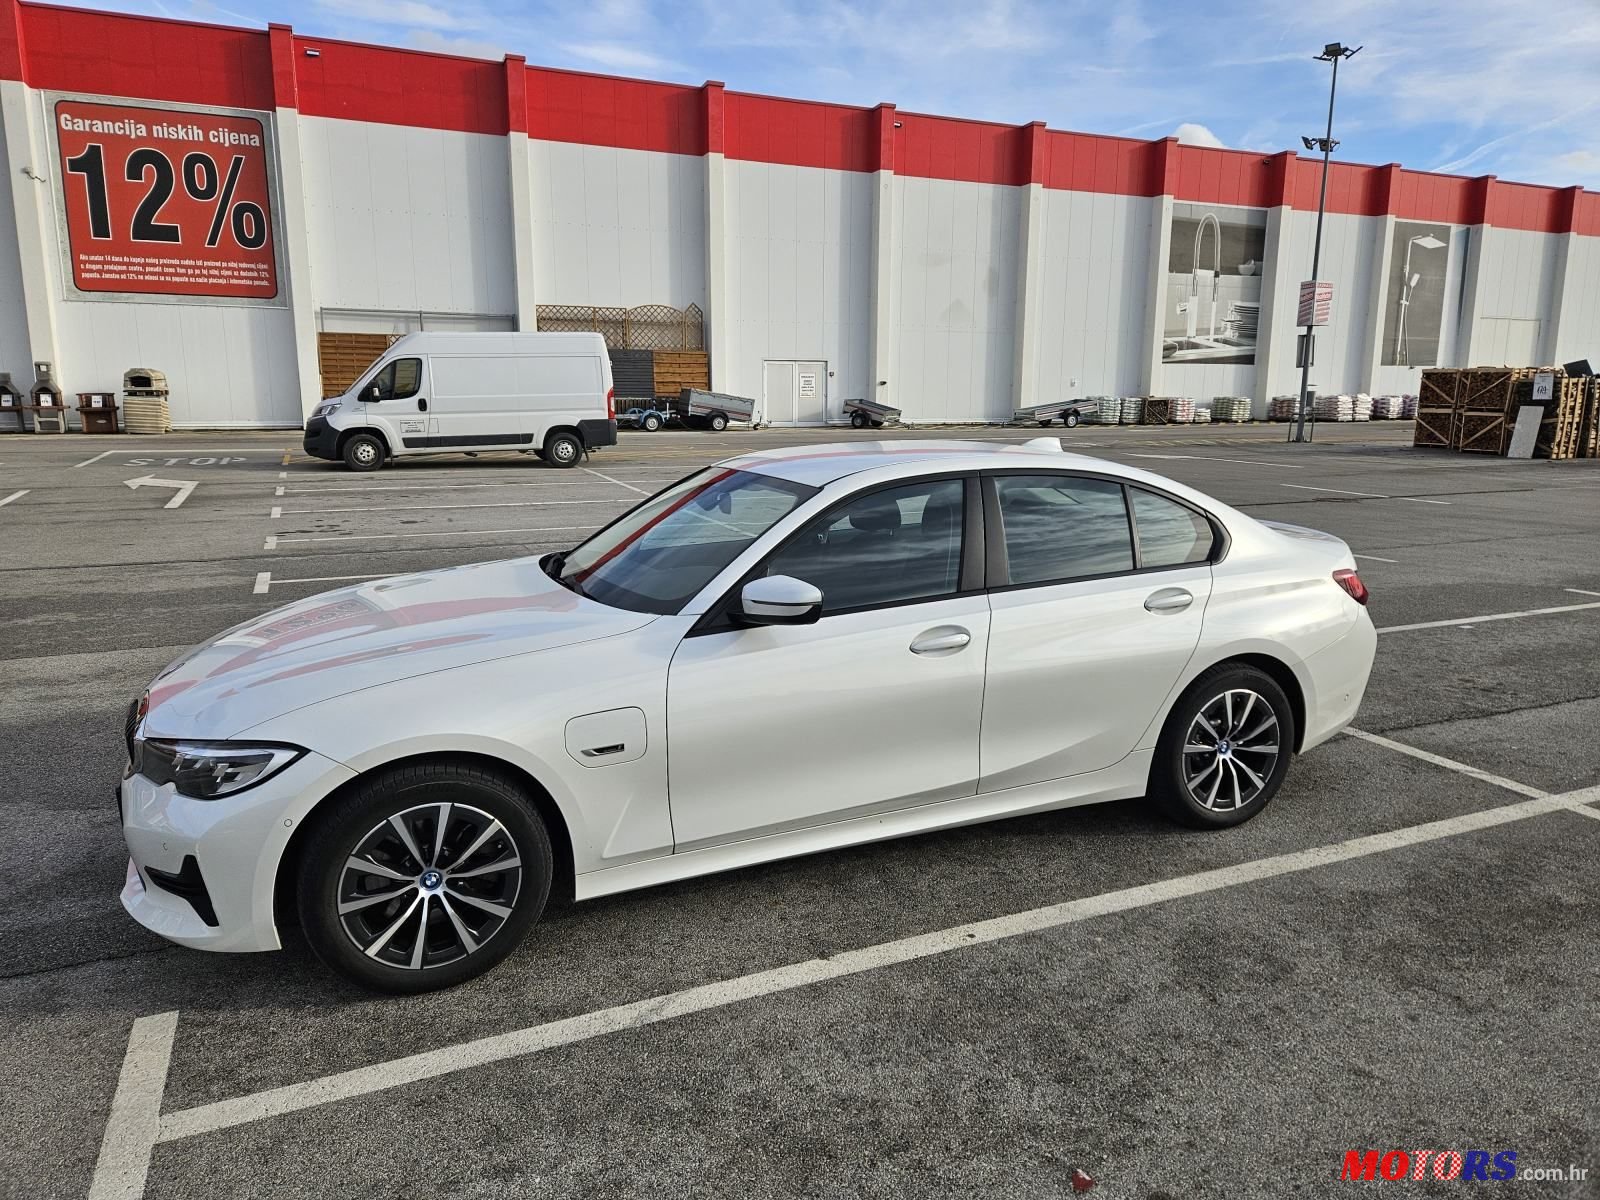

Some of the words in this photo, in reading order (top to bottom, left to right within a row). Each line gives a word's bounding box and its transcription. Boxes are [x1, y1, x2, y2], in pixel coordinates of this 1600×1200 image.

[60, 113, 146, 139] Garancija
[152, 122, 204, 142] niskih
[209, 128, 260, 147] cijena
[66, 142, 267, 250] 12%
[122, 457, 247, 467] STOP
